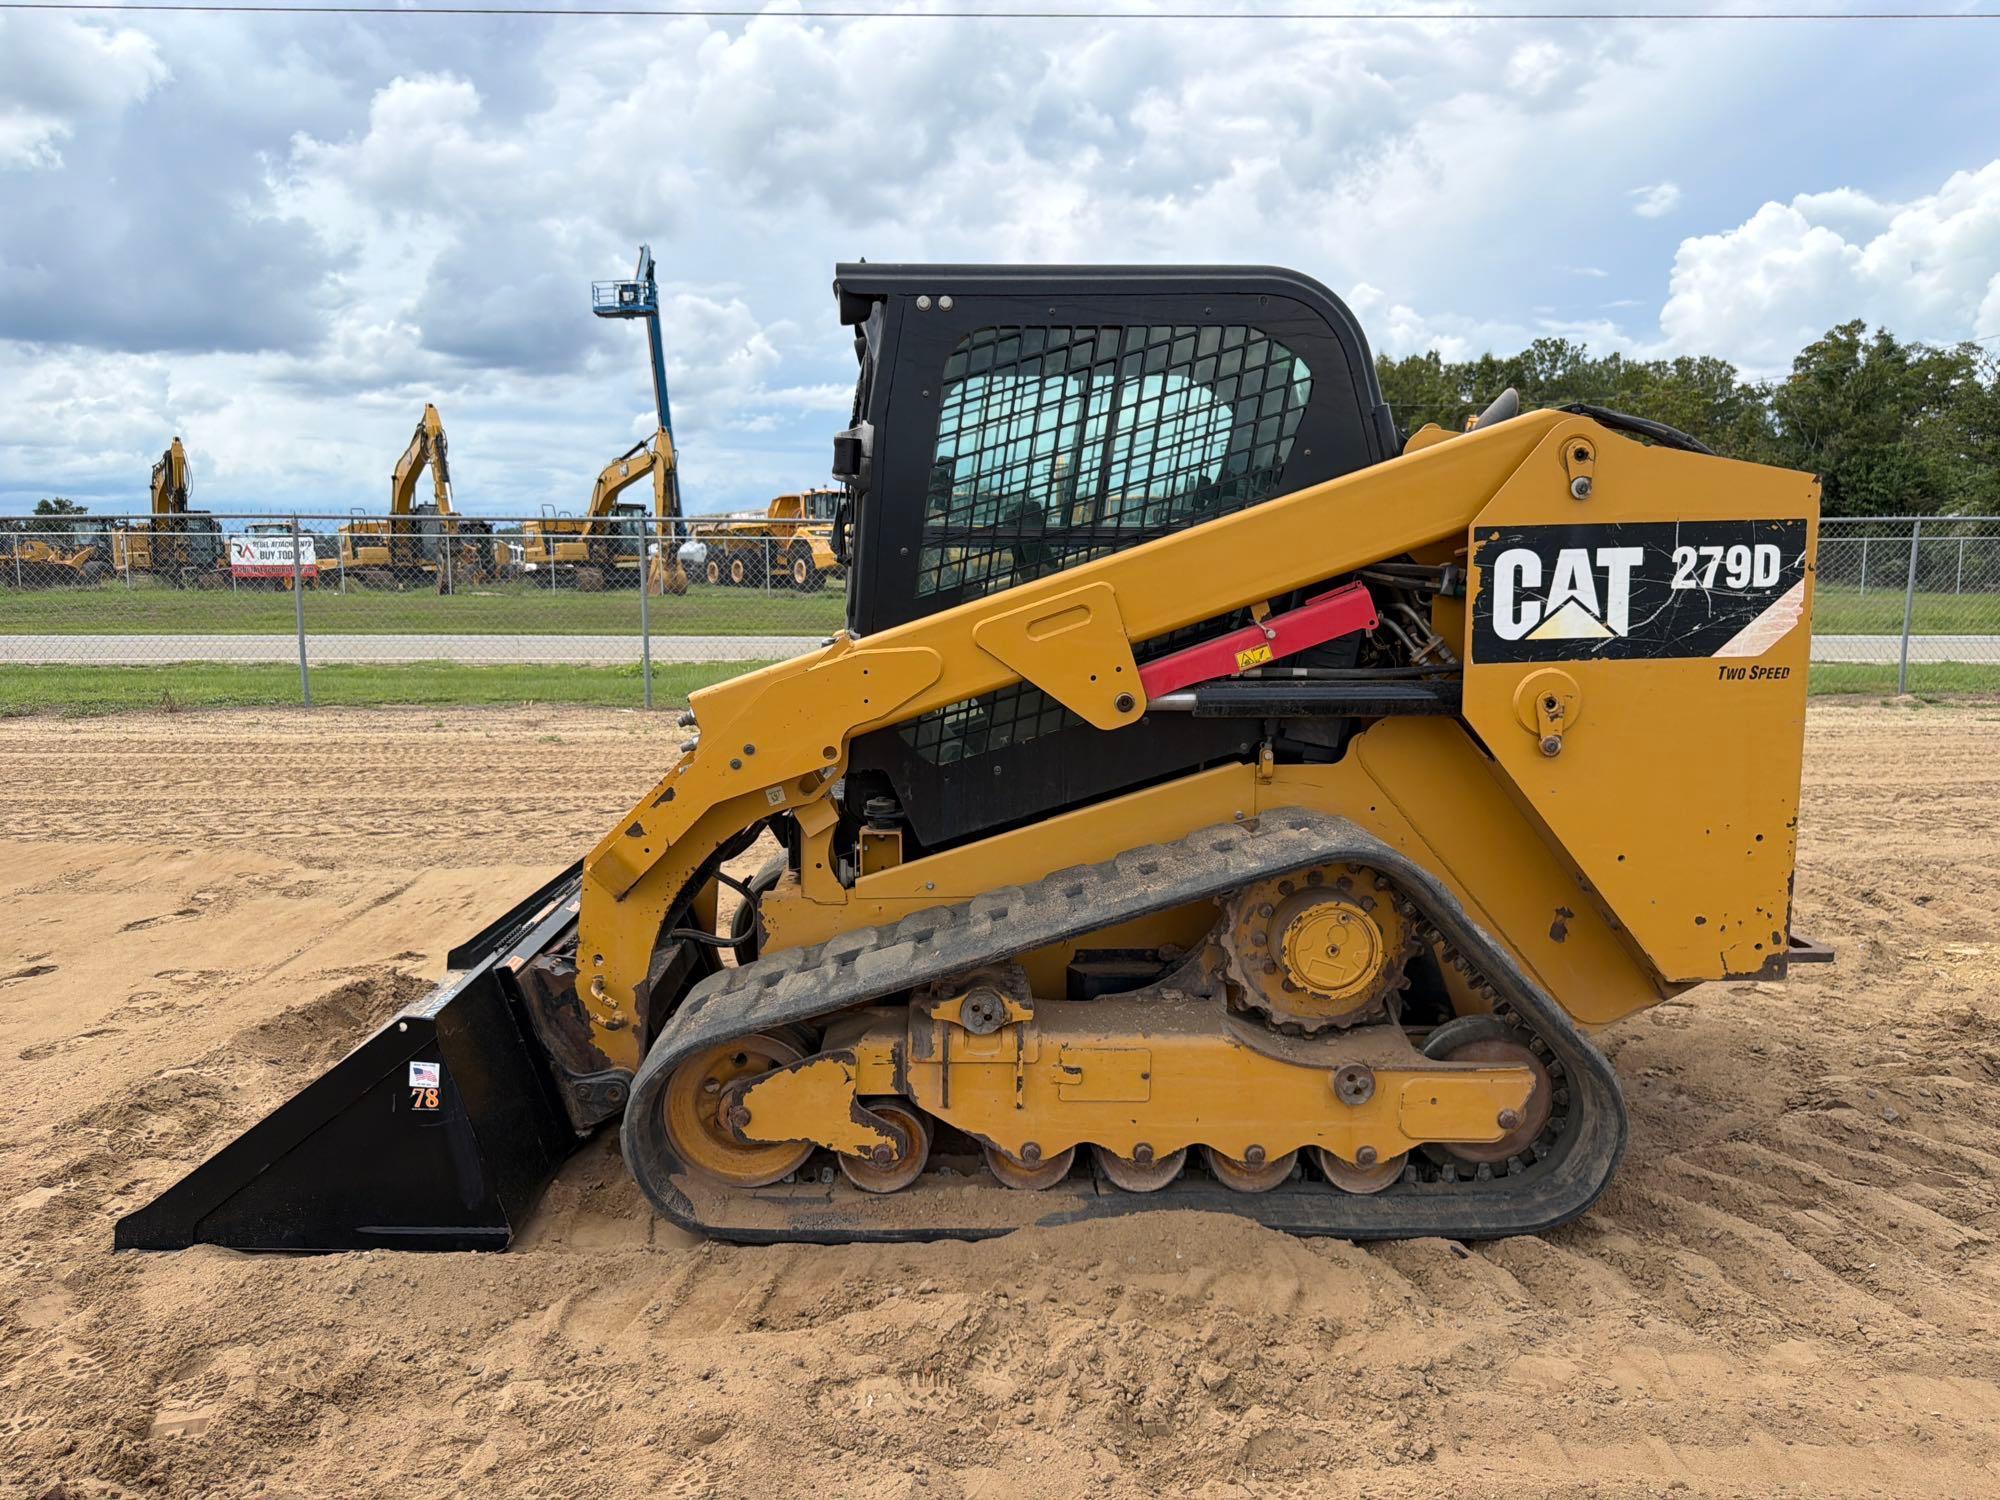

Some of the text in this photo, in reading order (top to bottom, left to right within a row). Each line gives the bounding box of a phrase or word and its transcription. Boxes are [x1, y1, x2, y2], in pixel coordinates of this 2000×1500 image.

[271, 540, 312, 549] ATTACHNTS
[260, 550, 305, 559] BUY TOD!
[1493, 544, 1781, 640] CAT 279D
[410, 1088, 439, 1108] 78
